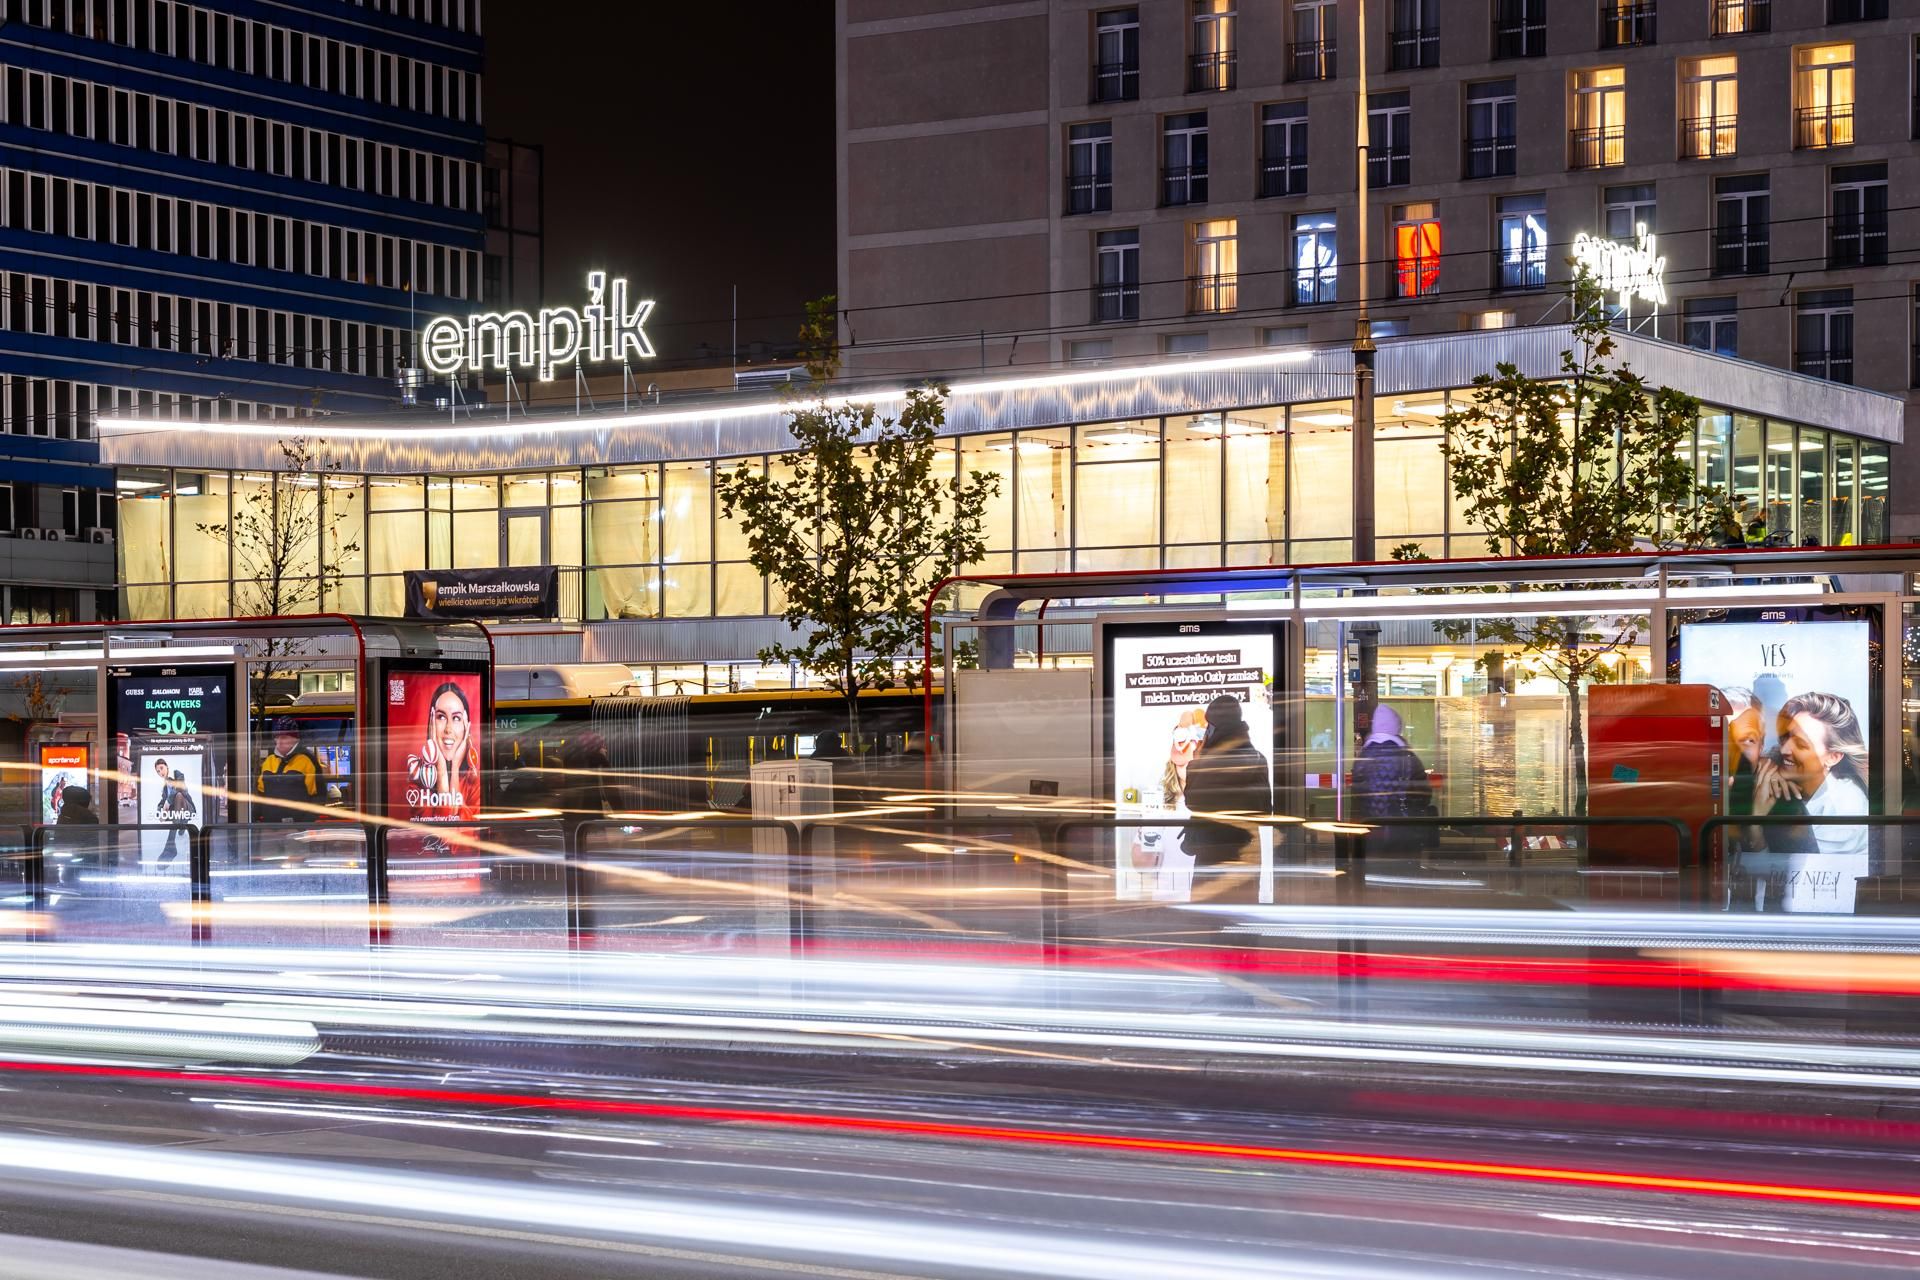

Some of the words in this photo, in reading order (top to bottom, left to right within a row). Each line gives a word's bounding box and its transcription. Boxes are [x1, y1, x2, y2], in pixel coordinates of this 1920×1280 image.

[423, 272, 656, 382] empik
[438, 582, 467, 596] empik
[468, 580, 540, 594] Marszałkowska
[438, 597, 464, 607] wielkie
[465, 595, 496, 606] otwarcie
[496, 594, 507, 606] już
[508, 594, 539, 604] wkrótce!
[1761, 611, 1786, 620] ams
[1179, 624, 1200, 633] ams
[1146, 655, 1165, 667] 50%
[1166, 653, 1216, 666] uczestników
[1216, 652, 1237, 664] testu
[1761, 643, 1786, 667] YES
[161, 668, 177, 676] ams
[1129, 676, 1137, 686] w
[1138, 674, 1169, 686] ciemno
[1204, 671, 1226, 685] Oatly
[1227, 669, 1259, 682] zamiast
[125, 688, 144, 696] GUESS
[1144, 692, 1171, 704] mleka
[1171, 691, 1210, 704] krowiego
[146, 700, 172, 709] BLACK
[173, 699, 201, 709] WEEKS
[420, 787, 464, 807] Homla
[1803, 870, 1841, 886] NIEJ
